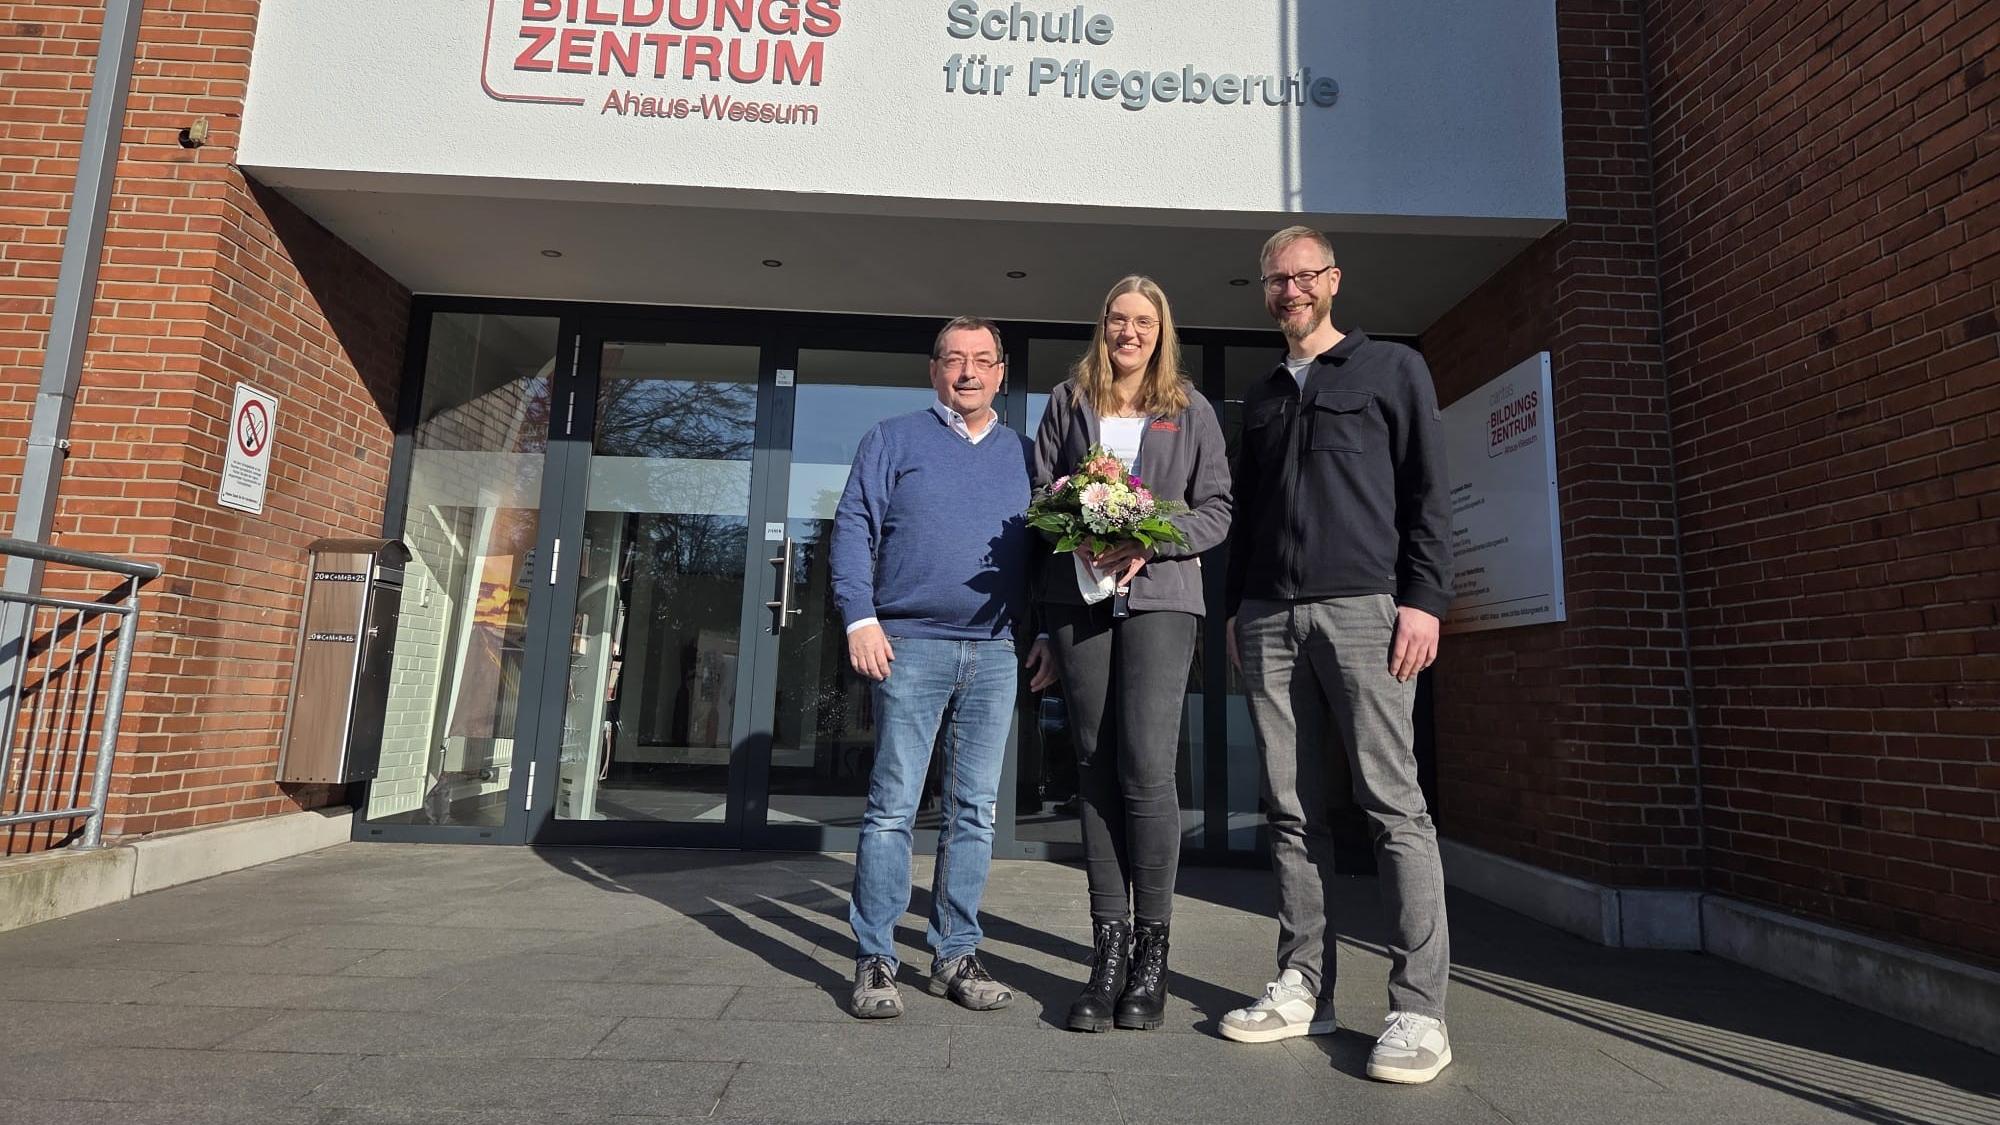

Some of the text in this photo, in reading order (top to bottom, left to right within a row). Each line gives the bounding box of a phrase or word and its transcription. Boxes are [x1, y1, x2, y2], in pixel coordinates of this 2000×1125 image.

[947, 0, 1114, 45] Schule
[514, 26, 824, 86] ZENTRUM
[943, 53, 1340, 111] für Pflegeberufe
[601, 89, 819, 125] Ahaus-Wessum
[1490, 390, 1538, 428] BILDUNGS
[1491, 411, 1537, 446] ZENTRUM
